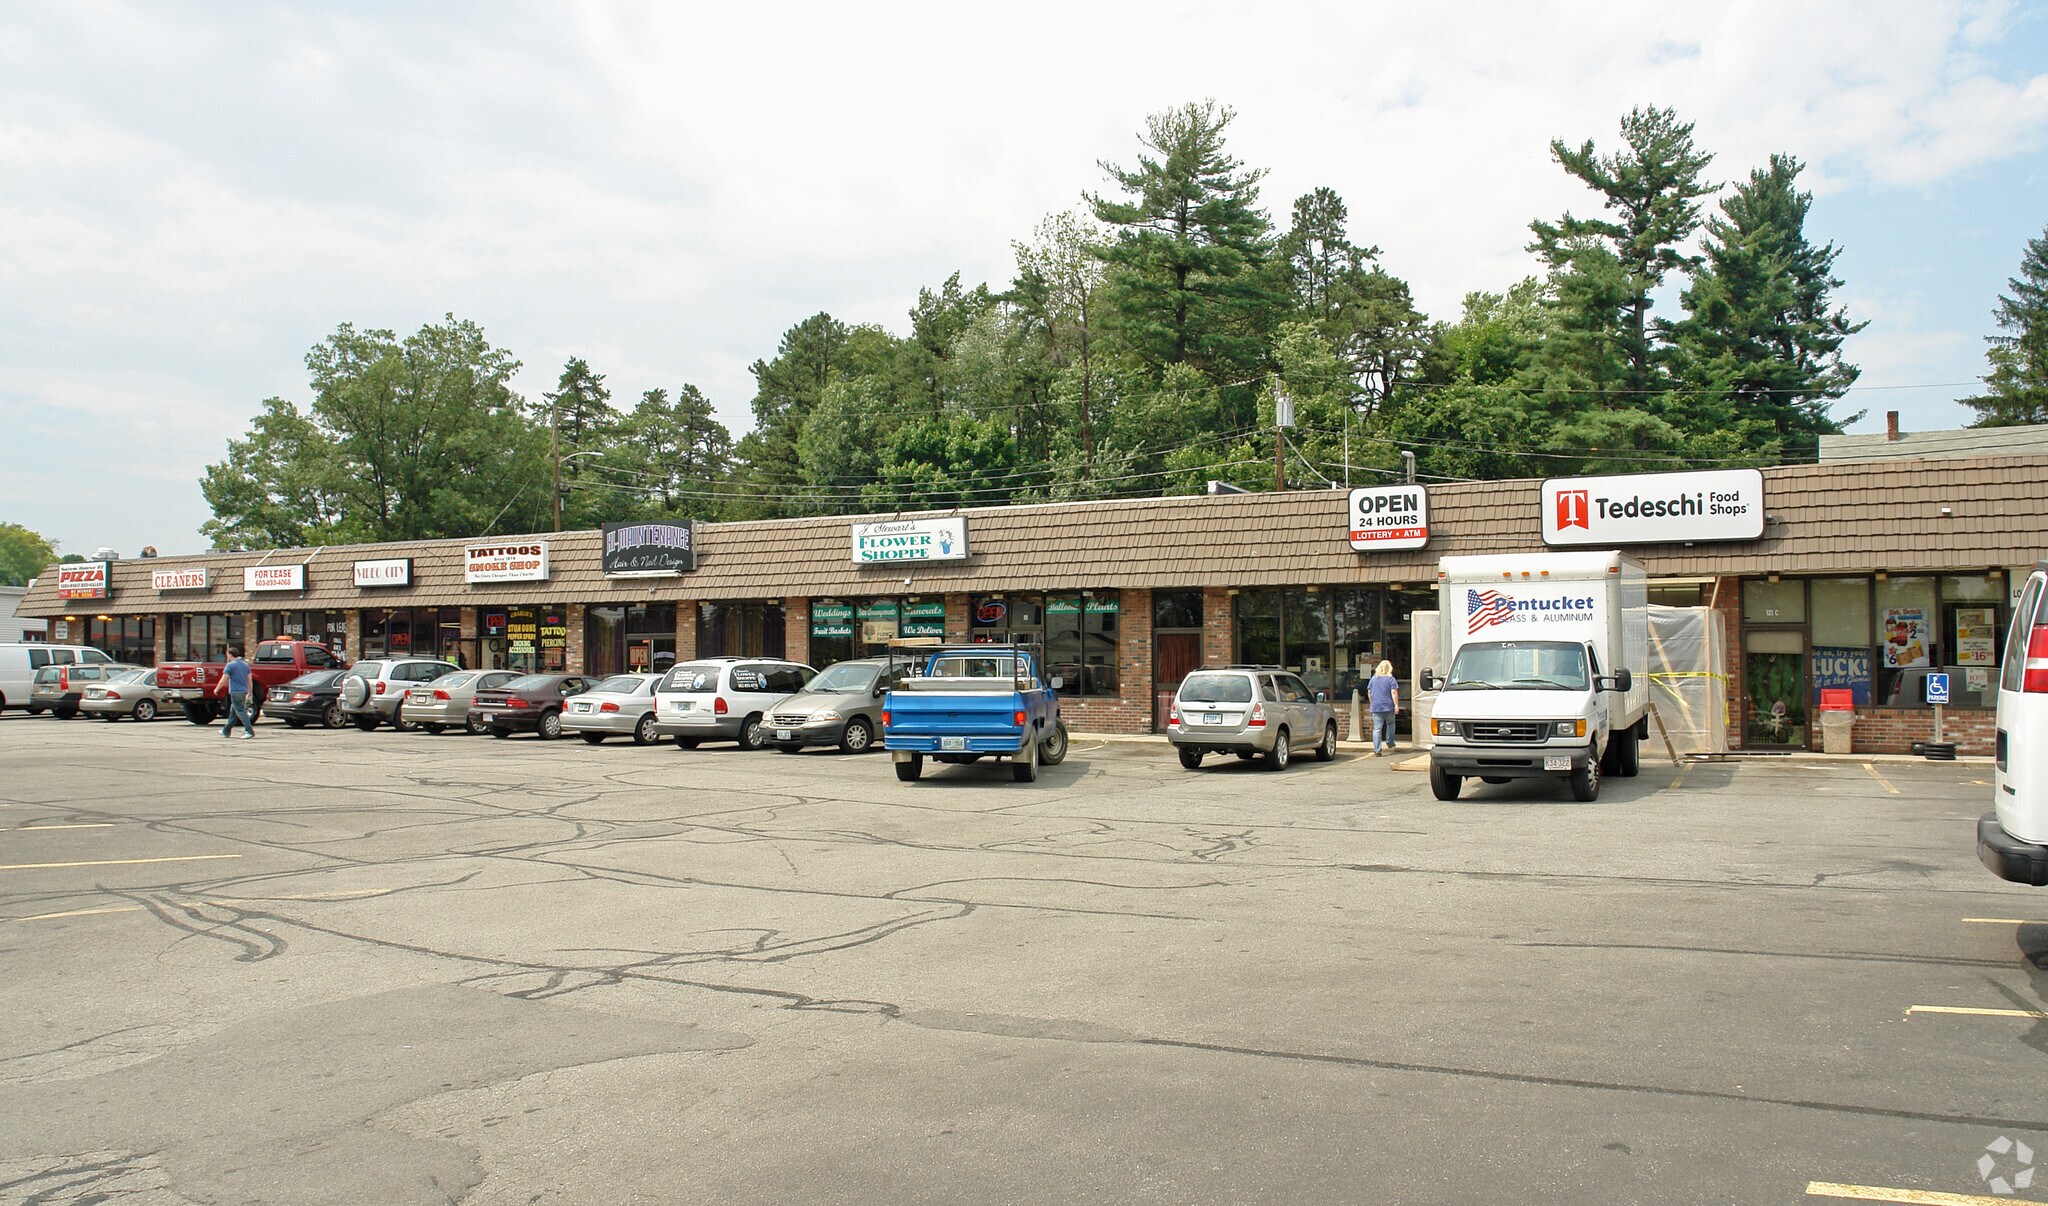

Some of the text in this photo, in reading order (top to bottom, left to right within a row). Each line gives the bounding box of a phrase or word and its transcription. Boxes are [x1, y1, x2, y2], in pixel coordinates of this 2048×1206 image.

[1710, 491, 1739, 502] Food
[1359, 494, 1418, 514] OPEN
[1595, 492, 1703, 519] Tedeschi
[874, 520, 916, 533] Stewart's
[1359, 515, 1418, 527] 24 HOURS
[606, 524, 690, 556] HI-MAINTENANCE
[1356, 529, 1421, 539] LOTTERY ATM
[859, 536, 932, 549] FLOWER
[468, 546, 541, 559] TATTOOS
[861, 548, 930, 562] SHOPPE
[469, 561, 541, 572] SMOKE SHOP
[609, 553, 683, 568] Hair & Nail Design
[60, 570, 105, 582] PIZZA
[254, 569, 292, 579] FOR LEASE
[357, 566, 405, 579] VIDEO CITY
[155, 574, 204, 588] CLEANERS
[1086, 602, 1118, 611] Plants
[1495, 596, 1594, 611] Pentucket
[813, 607, 852, 618] Weddings
[904, 606, 942, 616] Funerals
[977, 606, 1004, 619] OPEN
[1498, 613, 1593, 623] GLASS & ALUMINUM
[337, 622, 347, 633] LEAS
[507, 624, 536, 633] STUN GUNS
[540, 627, 566, 636] TATTOO
[813, 627, 852, 635] Fruit Baskets
[904, 626, 916, 634] We
[917, 625, 943, 634] Deliver
[541, 638, 565, 647] PIERCING
[631, 648, 646, 663] OPEN
[1811, 658, 1868, 676] LUCK!
[1824, 676, 1831, 686] in
[1833, 674, 1845, 685] the
